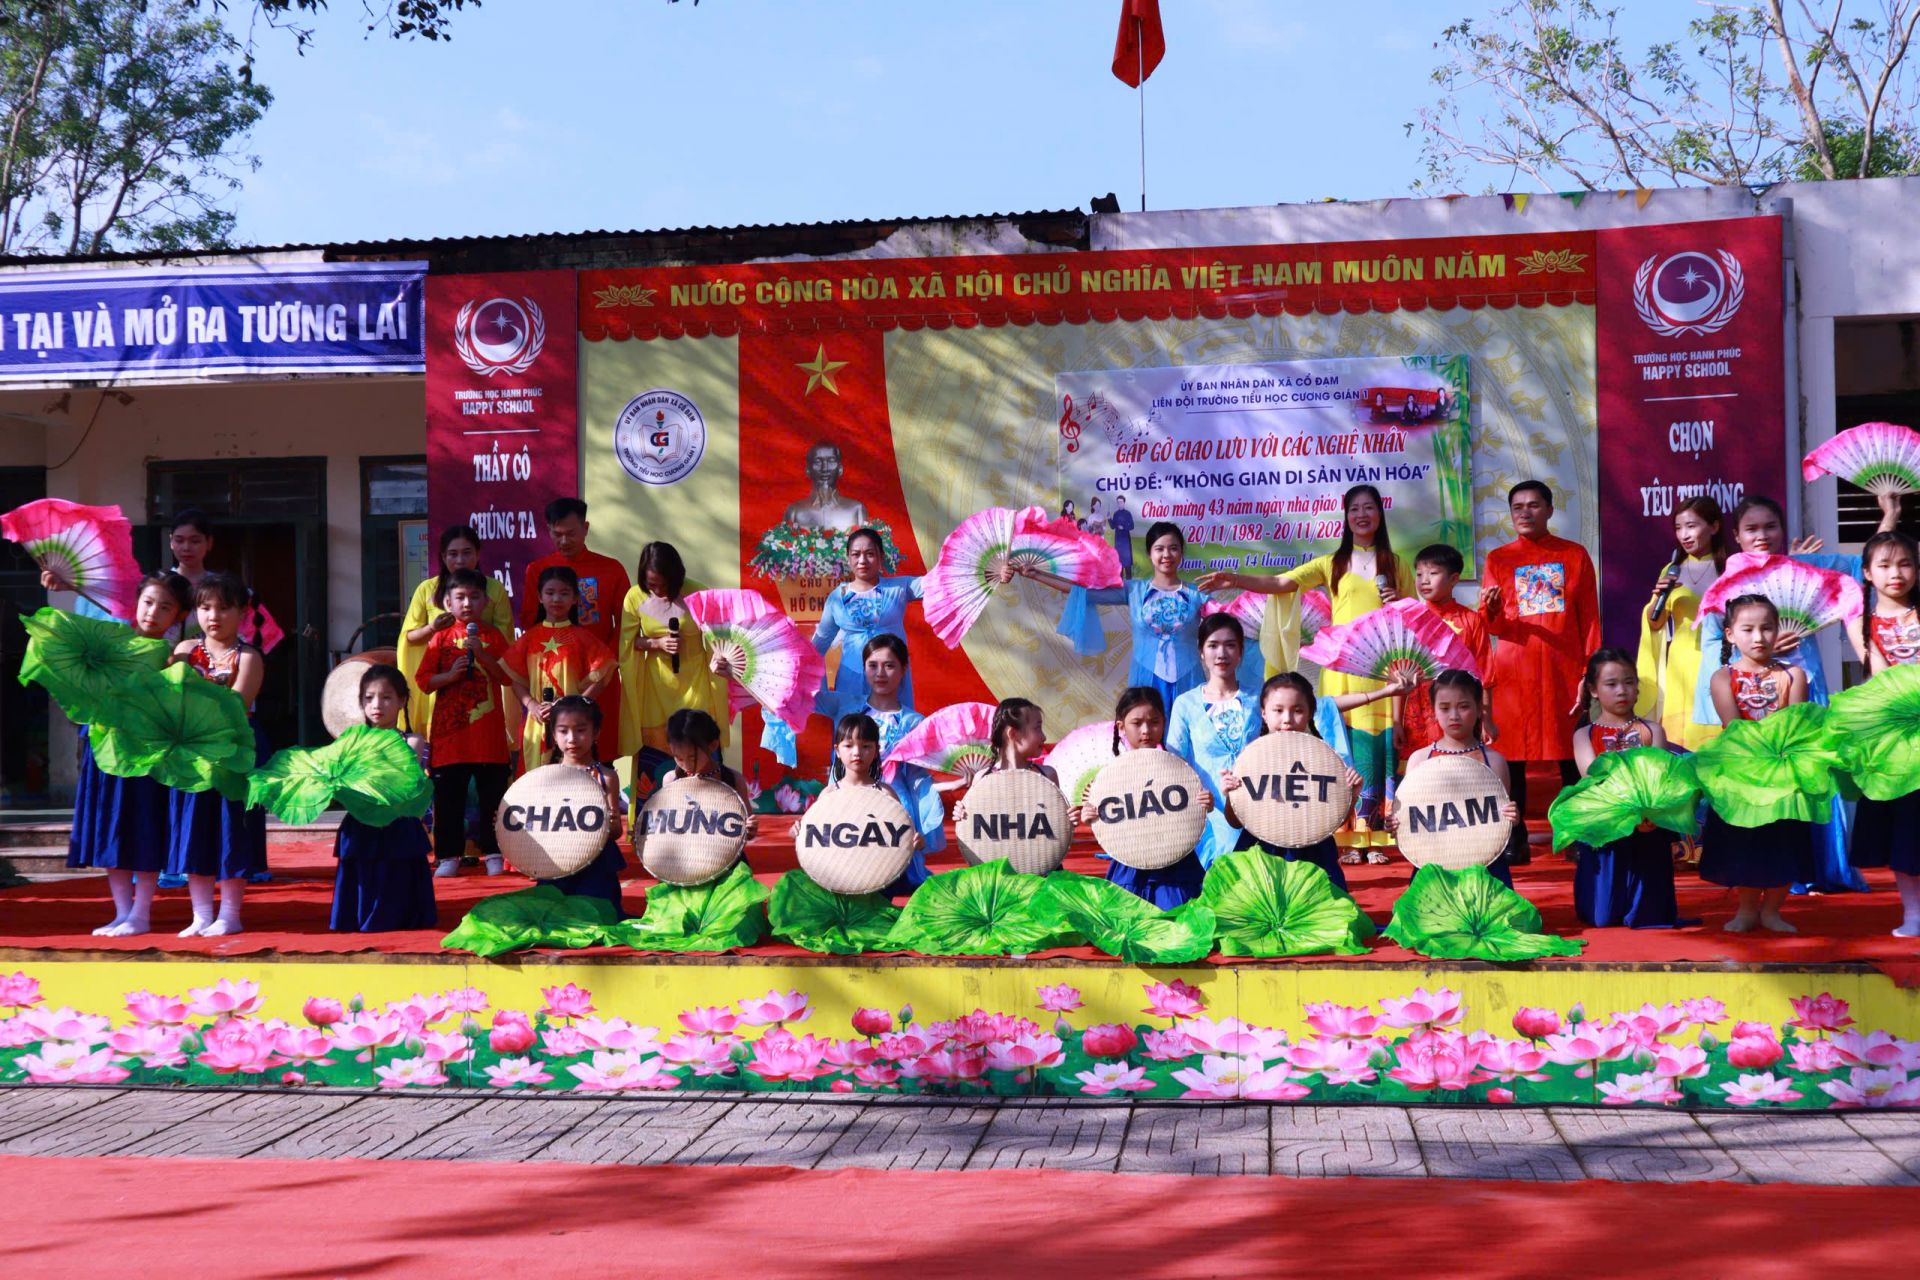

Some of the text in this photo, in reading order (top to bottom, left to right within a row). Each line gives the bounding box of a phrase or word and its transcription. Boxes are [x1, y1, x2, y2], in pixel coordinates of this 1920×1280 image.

[671, 250, 1506, 308] NƯỚC CỘNG HÒA XÃ HỘI CHỦ NGHĨA VIỆT NAM MUÔN NĂM
[13, 312, 64, 358] TẠI
[72, 302, 115, 348] VÀ
[124, 295, 178, 346] MỞ
[187, 305, 227, 344] RA
[238, 301, 347, 343] TƯƠNG
[358, 302, 408, 341] LAI
[1633, 347, 1741, 364] TRƯỜNG HỌC HẠNH PHÚC
[1643, 361, 1731, 380] HAPPY SCHOOL
[454, 387, 483, 400] TRƯỜNG
[485, 389, 499, 400] HỌC
[523, 387, 543, 397] PHÚC
[1152, 388, 1367, 408] LIÊN ĐỘI TRƯỜNG TIỂU HỌC CƯƠNG GIÁN 1
[1181, 380, 1193, 391] ỦY
[1197, 381, 1217, 391] BAN
[1220, 378, 1249, 389] NHÂN
[1252, 377, 1274, 389] DÂN
[1278, 377, 1292, 387] XÃ
[1315, 376, 1339, 388] ĐẠM
[462, 400, 534, 415] HAPPY SCHOOL
[1116, 427, 1407, 468] GẶP GỠ GIAO LƯU VỚI CÁC NGHỆ NHÂN
[1669, 420, 1714, 460] CHỌN
[473, 440, 531, 482] THẦY CÔ
[1095, 473, 1130, 491] CHỦ
[1135, 472, 1162, 490] ĐỀ:
[1238, 471, 1280, 486] GIAN
[1286, 470, 1302, 484] DI
[1307, 465, 1341, 483] SẢN
[1345, 465, 1380, 482] VĂN
[1141, 500, 1169, 519] Chào
[1172, 498, 1205, 520] mừng
[1208, 498, 1224, 515] 43
[1227, 498, 1253, 516] năm
[1256, 496, 1284, 519] ngày
[1287, 494, 1310, 513] nhà
[1312, 493, 1338, 516] giáo
[1640, 477, 1674, 517] YÊU
[469, 504, 538, 540] CHÚNG TA
[1187, 523, 1263, 546] 20/11/1982
[1273, 521, 1344, 544] 20/11/202
[1210, 552, 1239, 570] ngày
[1245, 554, 1258, 566] 14
[1261, 552, 1296, 568] tháng
[1099, 778, 1190, 824] GIÁO
[1240, 761, 1337, 809] VIỆT
[805, 814, 911, 848] NGÀY
[972, 802, 1056, 840] NHÀ
[1408, 796, 1500, 834] NAM
